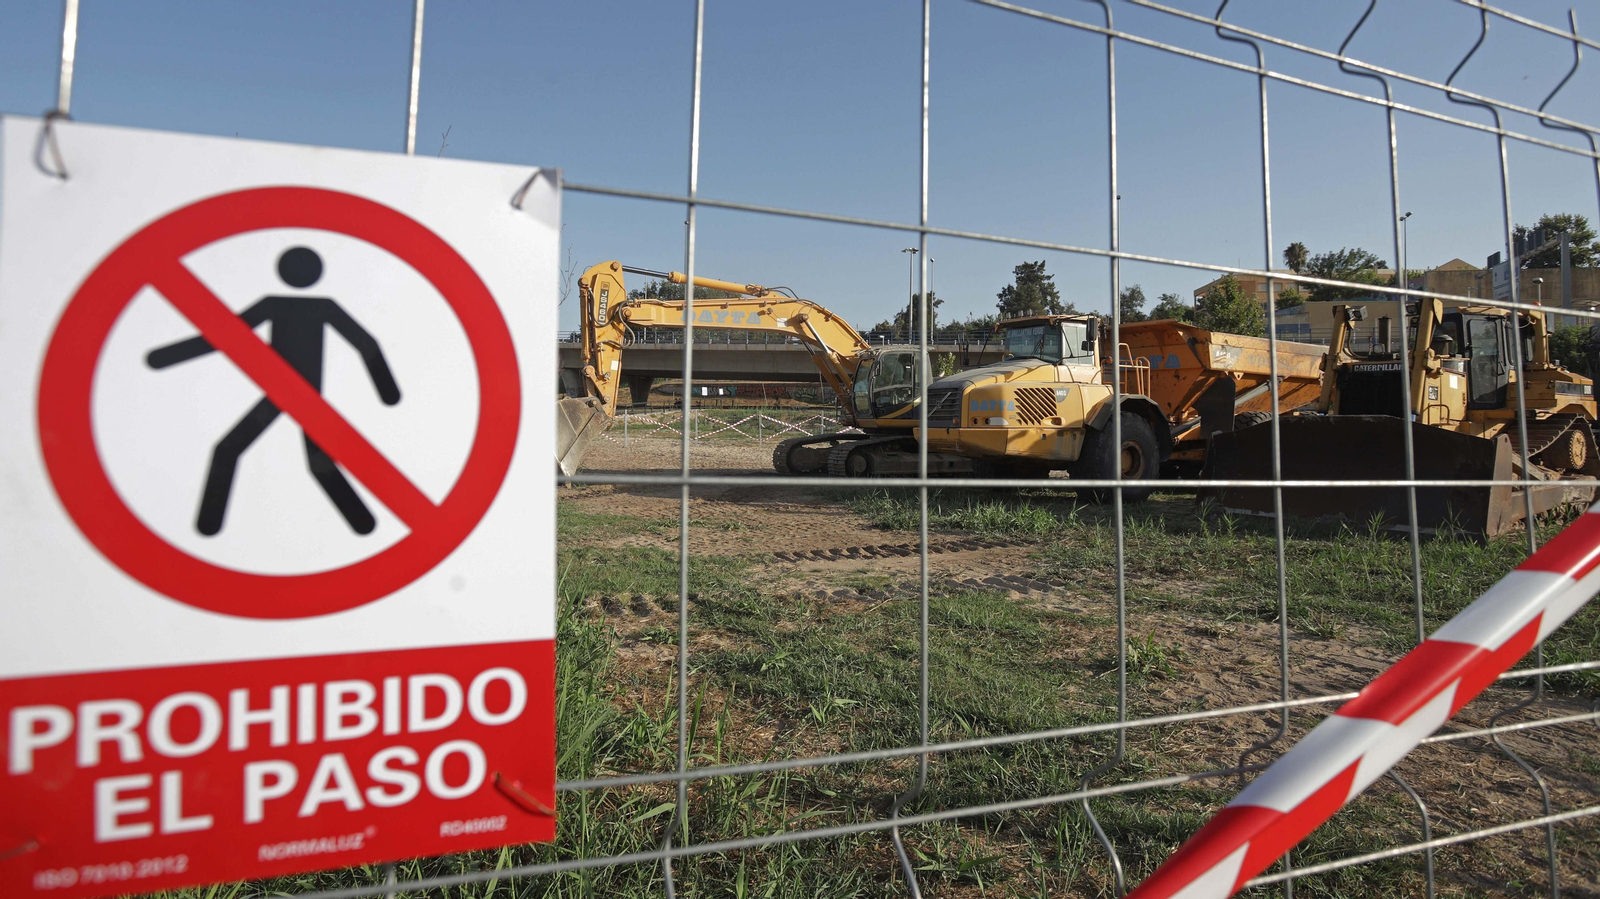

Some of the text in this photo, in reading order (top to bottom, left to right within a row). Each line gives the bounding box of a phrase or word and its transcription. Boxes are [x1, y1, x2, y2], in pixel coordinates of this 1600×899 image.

[970, 400, 1015, 412] DAYTA
[8, 667, 528, 775] PROHIBIDO
[94, 739, 488, 843] EL PASO
[33, 866, 79, 890] ISO
